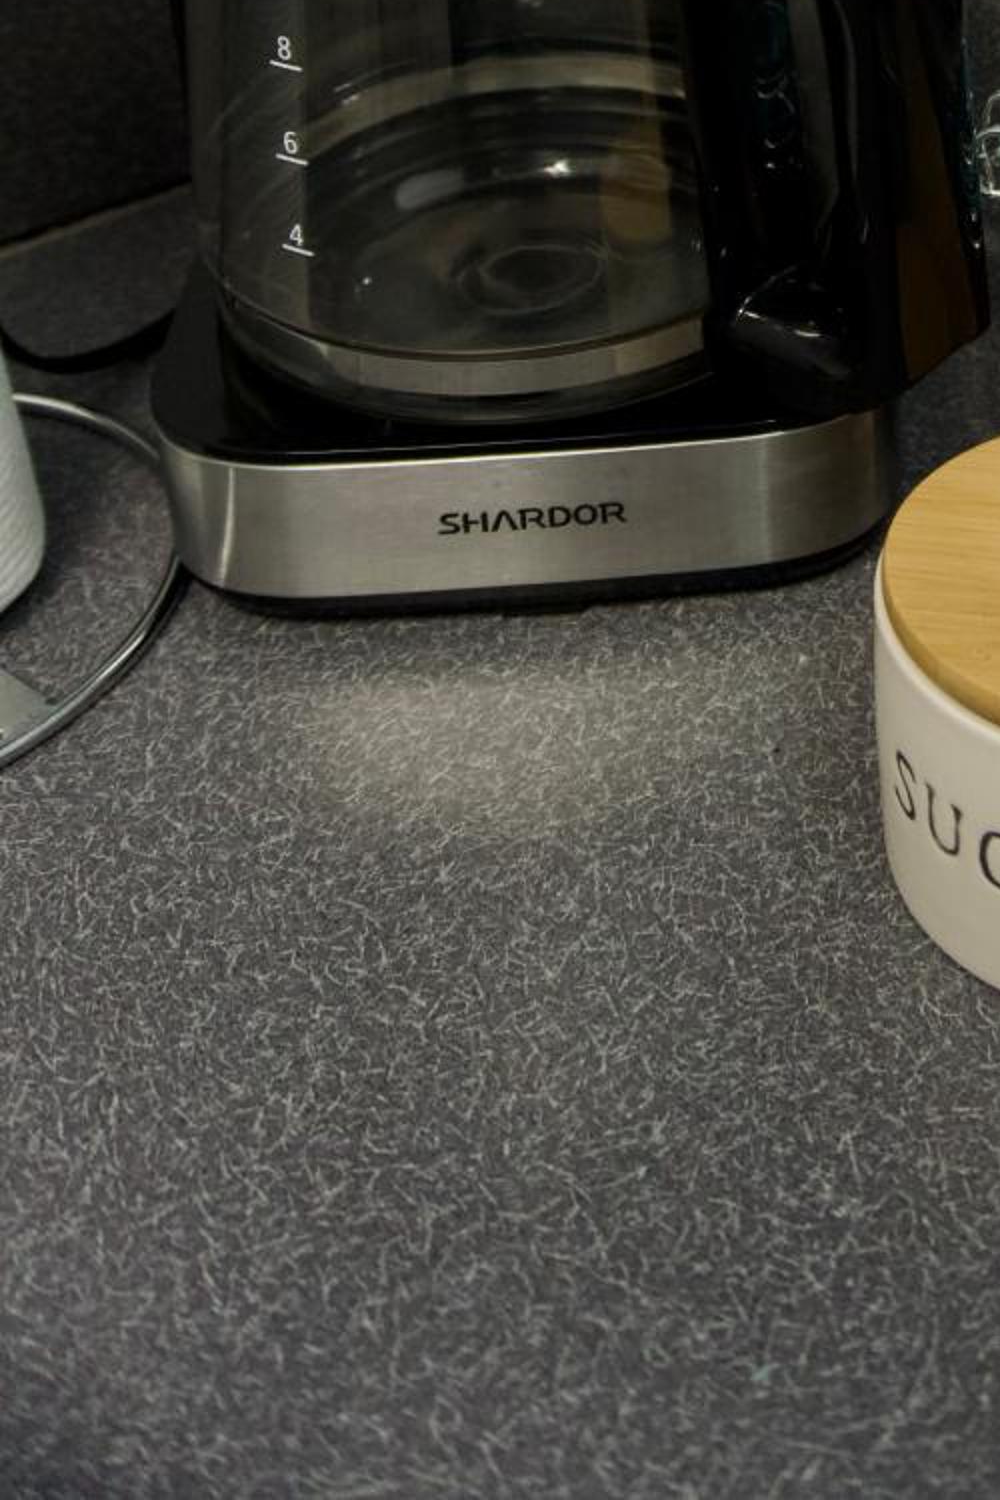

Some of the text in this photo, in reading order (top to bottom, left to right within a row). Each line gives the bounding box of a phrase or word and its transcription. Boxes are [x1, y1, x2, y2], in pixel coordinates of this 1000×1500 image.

[278, 36, 292, 60] 8
[283, 131, 298, 154] 6
[289, 223, 304, 246] 4
[438, 501, 628, 536] SHARDOR
